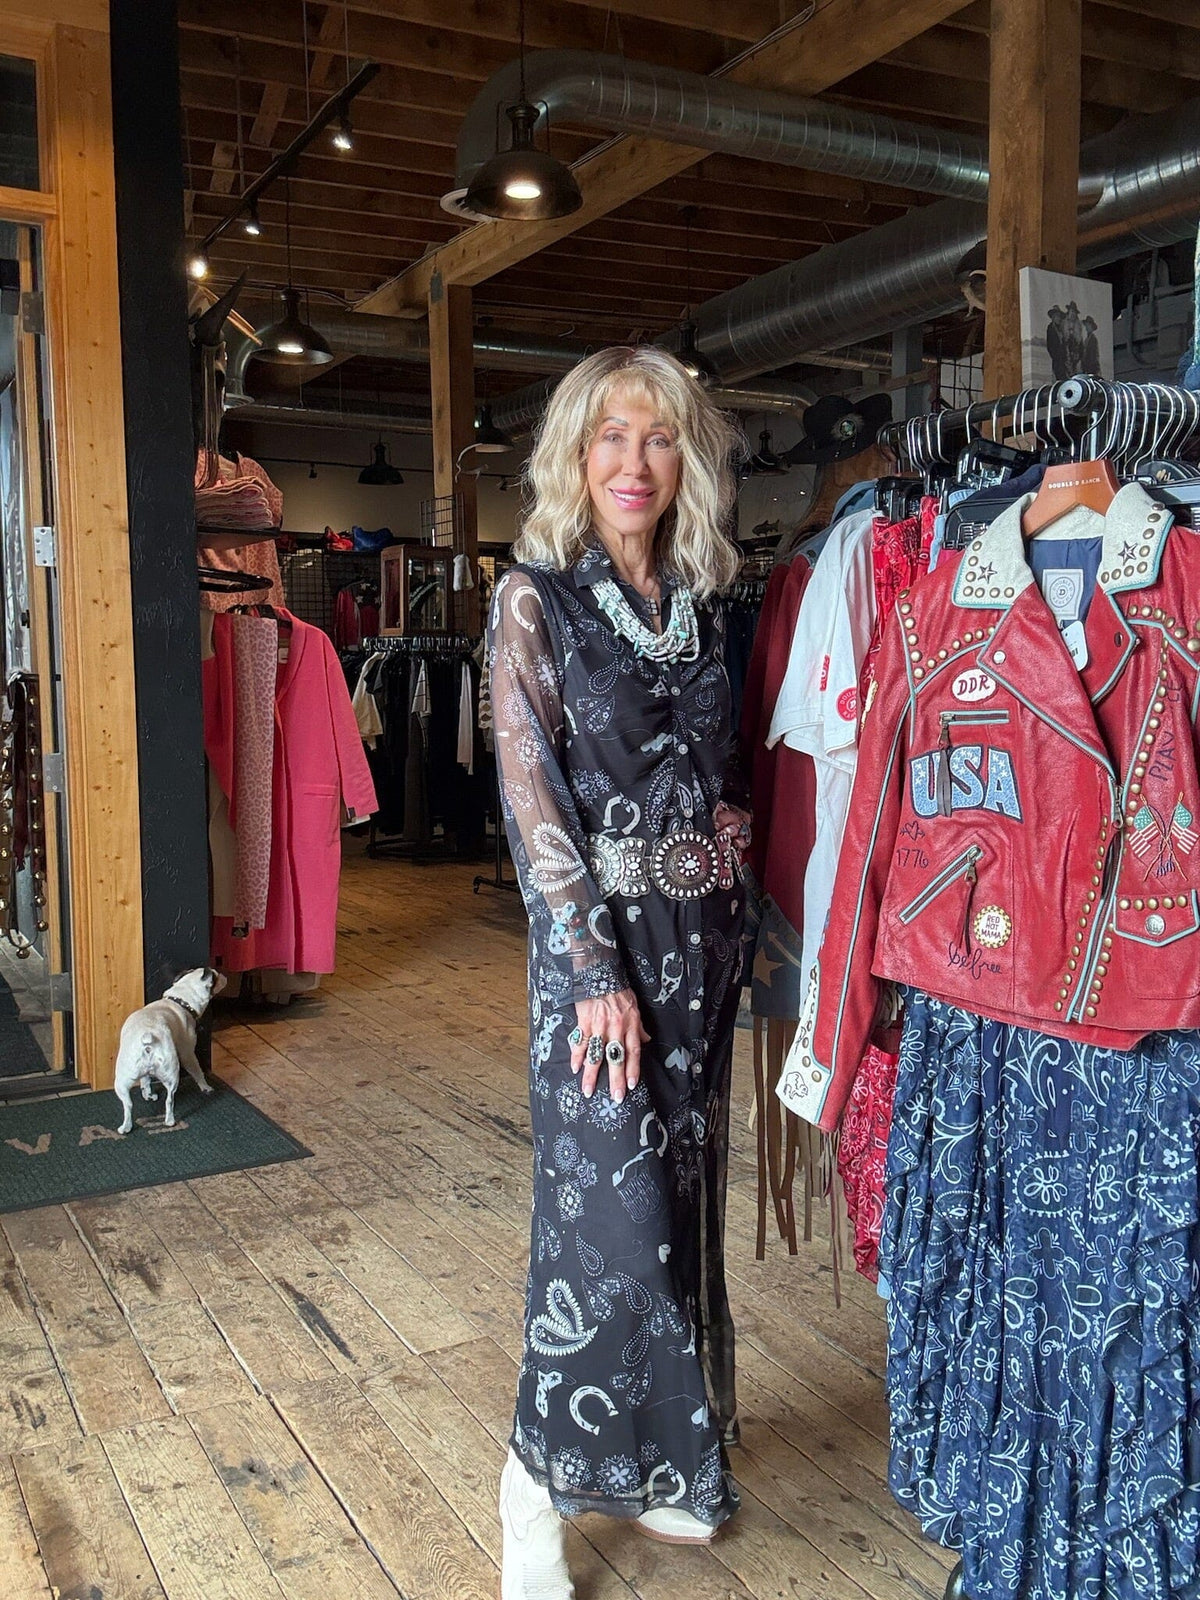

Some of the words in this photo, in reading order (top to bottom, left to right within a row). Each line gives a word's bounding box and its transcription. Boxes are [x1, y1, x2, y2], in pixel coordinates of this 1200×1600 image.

[1048, 480, 1073, 489] DOUBLE
[957, 674, 991, 696] DDR
[909, 743, 1024, 823] USA
[896, 847, 929, 869] 1776
[985, 922, 1000, 930] HOT
[987, 914, 1001, 924] RED
[981, 930, 1002, 939] MAMA
[947, 941, 970, 968] be
[968, 948, 1002, 980] free
